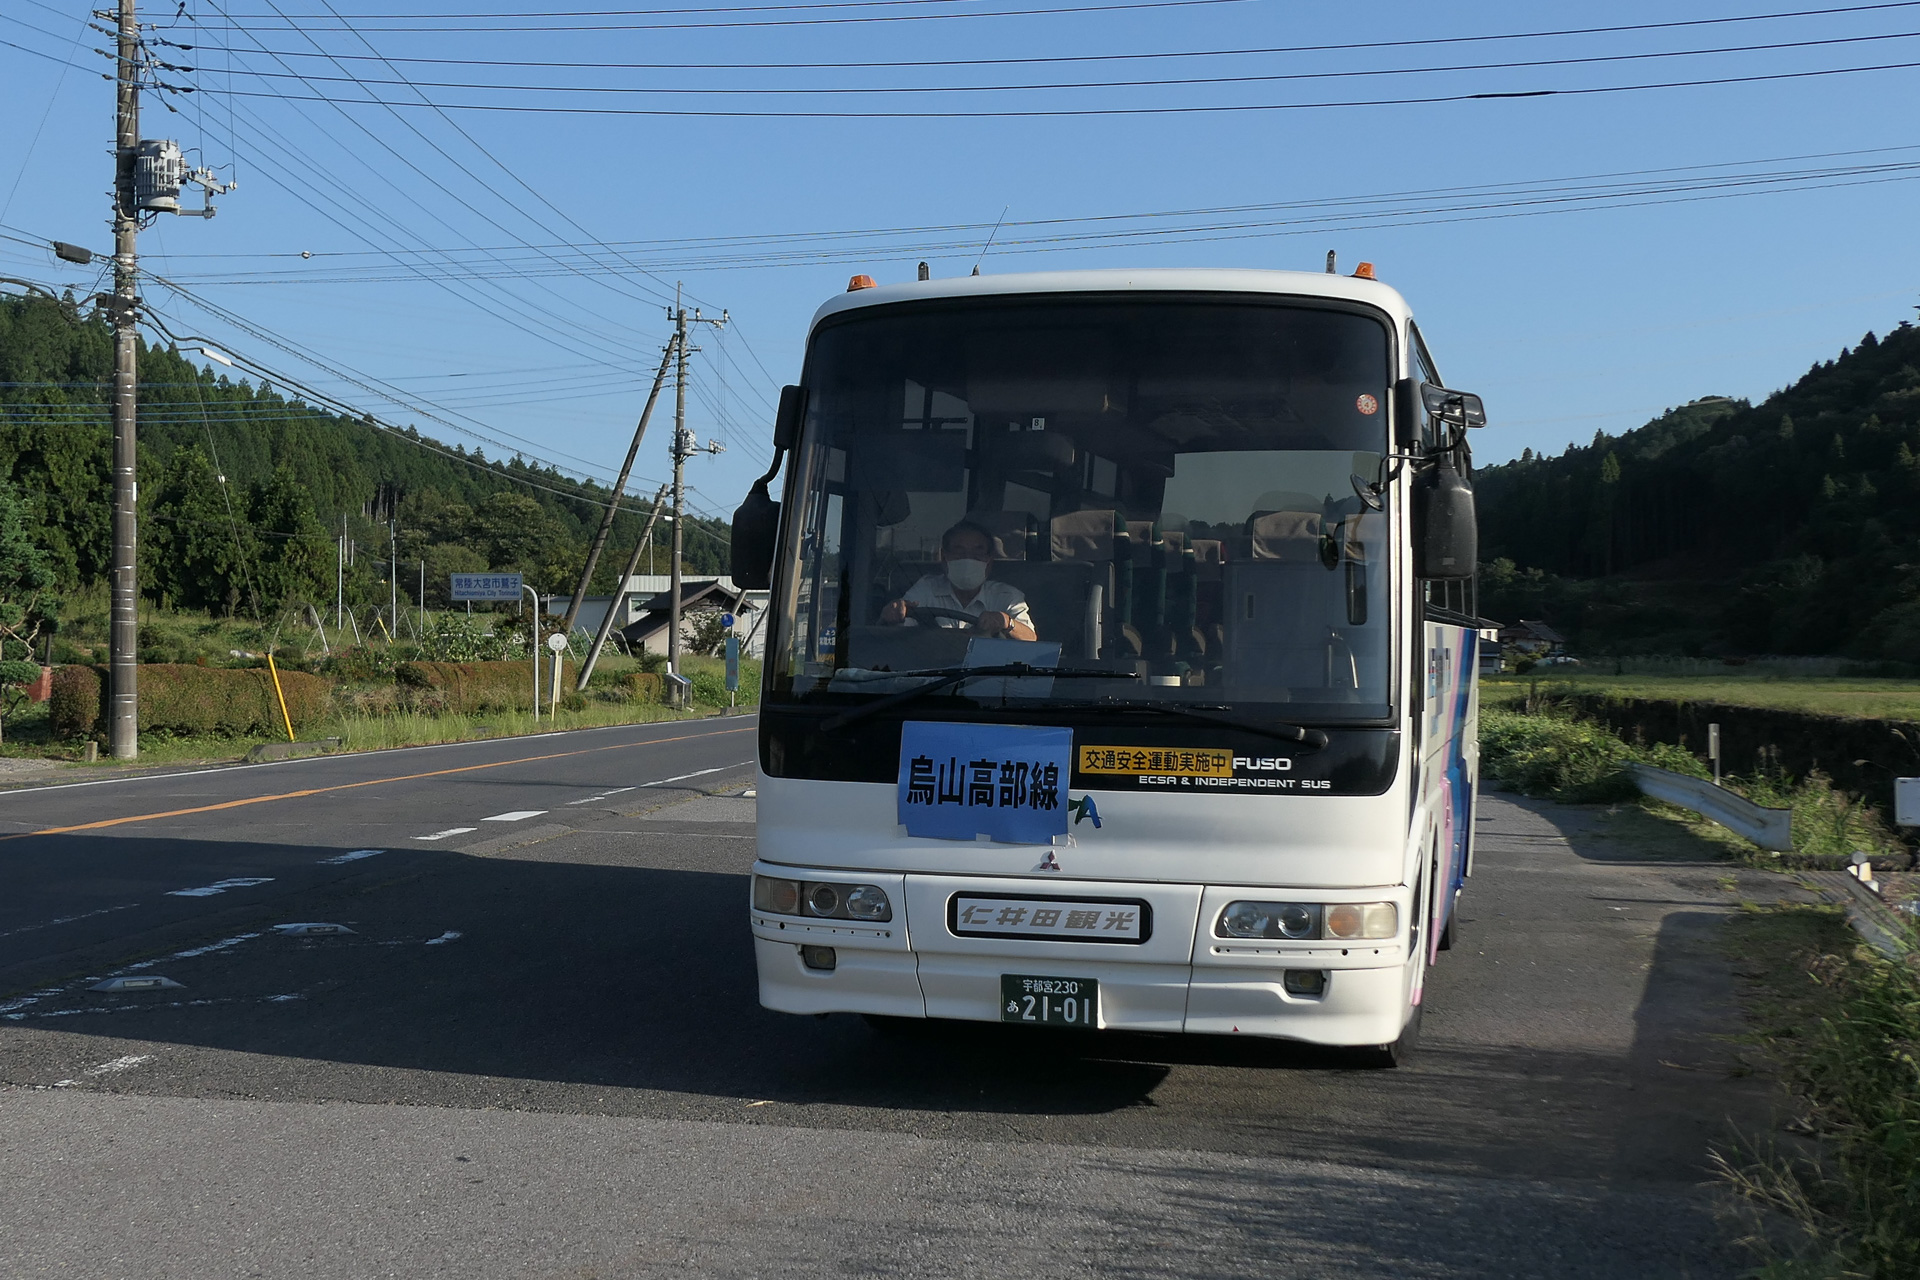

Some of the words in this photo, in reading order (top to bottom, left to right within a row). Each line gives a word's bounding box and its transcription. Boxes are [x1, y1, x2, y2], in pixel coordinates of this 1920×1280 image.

[455, 577, 519, 589] 常陸大宮市鷲子
[1085, 750, 1227, 773] 交通安全運動実施中
[1232, 757, 1292, 771] FUSO
[1139, 775, 1177, 786] ECSA
[1181, 777, 1191, 786] &
[1195, 777, 1296, 788] INDEPENDENT
[1301, 780, 1331, 789] SUS
[960, 905, 1136, 931] 仁井田観光
[1006, 999, 1019, 1014] あ
[1022, 994, 1090, 1024] 21-01
